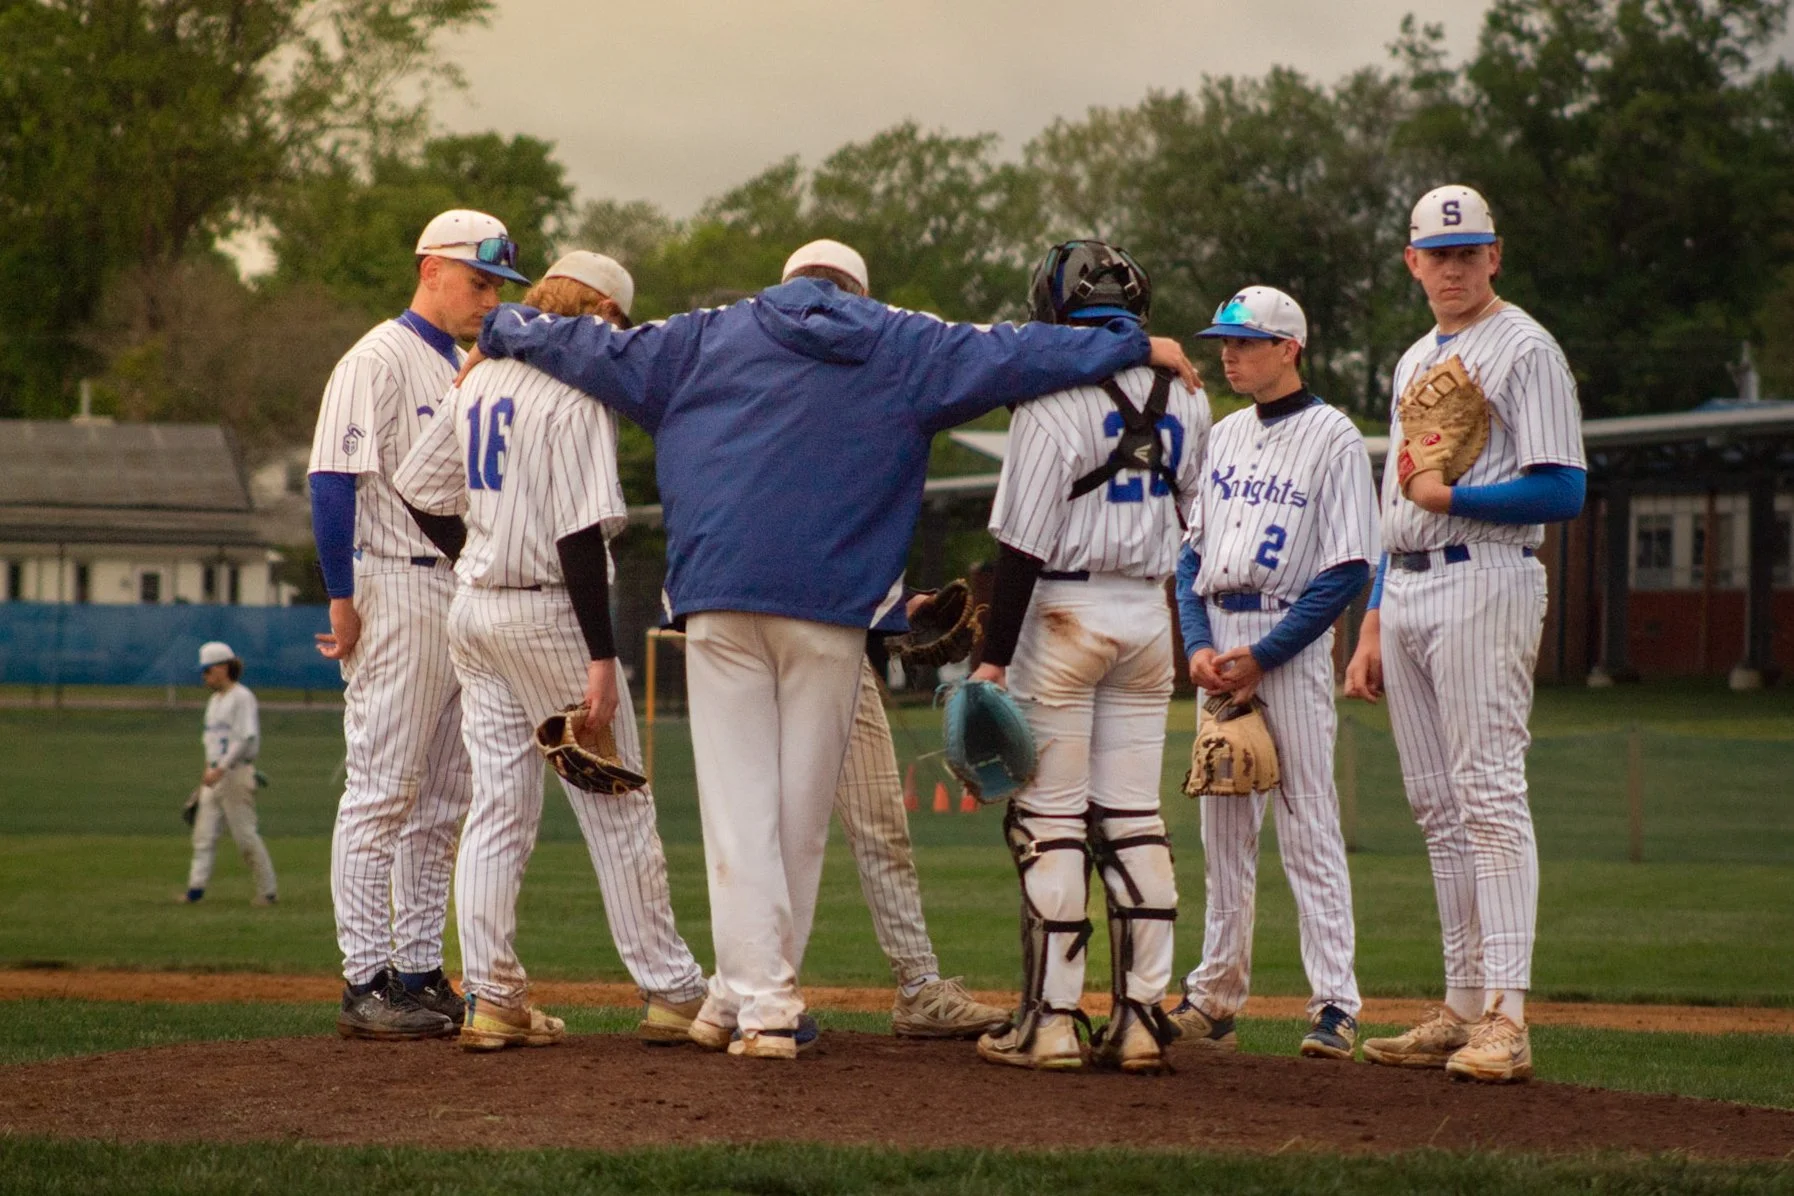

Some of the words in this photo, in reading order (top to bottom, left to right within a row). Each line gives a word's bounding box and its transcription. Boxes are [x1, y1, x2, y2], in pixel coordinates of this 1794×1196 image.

[1442, 200, 1461, 226] S
[467, 396, 515, 491] 16
[1103, 411, 1184, 503] 20
[1211, 465, 1307, 508] Knights
[1255, 524, 1287, 571] 2
